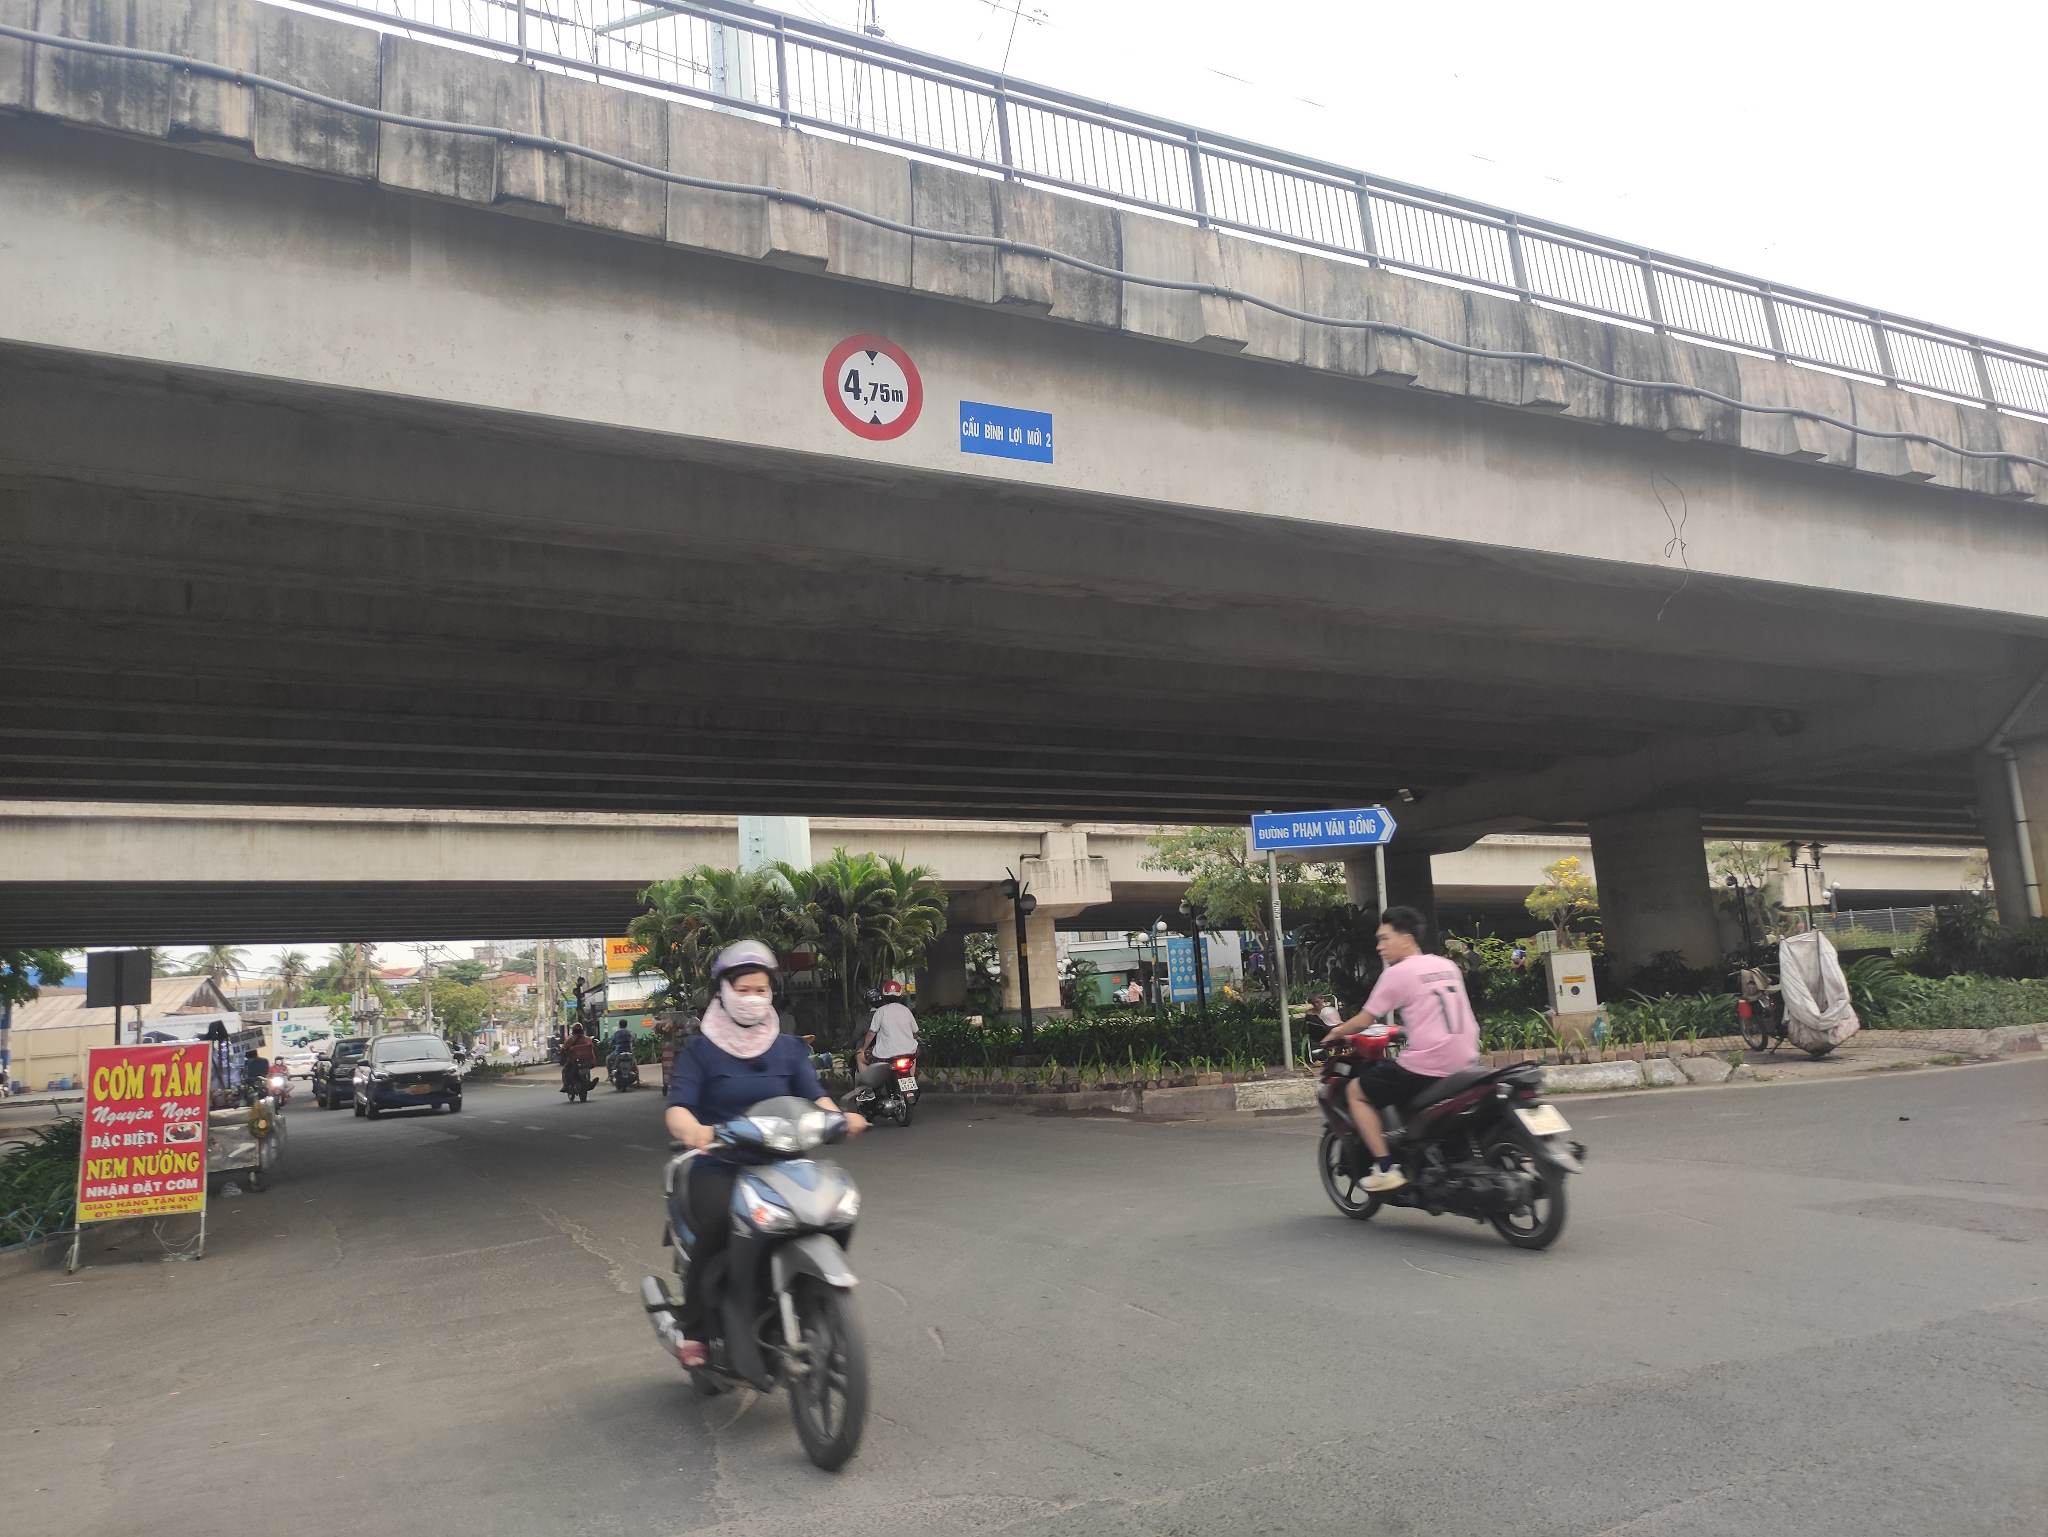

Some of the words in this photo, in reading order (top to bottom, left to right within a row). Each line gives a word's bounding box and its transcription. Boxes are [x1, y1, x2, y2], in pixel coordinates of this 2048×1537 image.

[844, 369, 904, 405] 4,75m
[962, 416, 980, 437] CẦU
[984, 421, 1004, 440] BÌNH
[1008, 427, 1022, 446] LỢI
[1027, 428, 1042, 446] MỚI
[1045, 432, 1052, 448] 2
[1258, 825, 1290, 840] ĐƯỜNG
[1292, 821, 1322, 840] PHẠM
[1325, 818, 1346, 837] VĂN
[1349, 813, 1376, 835] ĐỒNG
[93, 1058, 146, 1101] CƠM
[90, 1132, 121, 1150] ĐẶC
[123, 1130, 159, 1148] BIỆT:
[86, 1157, 129, 1181] NEM
[132, 1148, 201, 1177] NƯỚNG
[86, 1182, 130, 1199] NHẬN
[132, 1180, 163, 1196] ĐẶT
[166, 1177, 199, 1191] CƠM
[84, 1202, 113, 1211] GIAO
